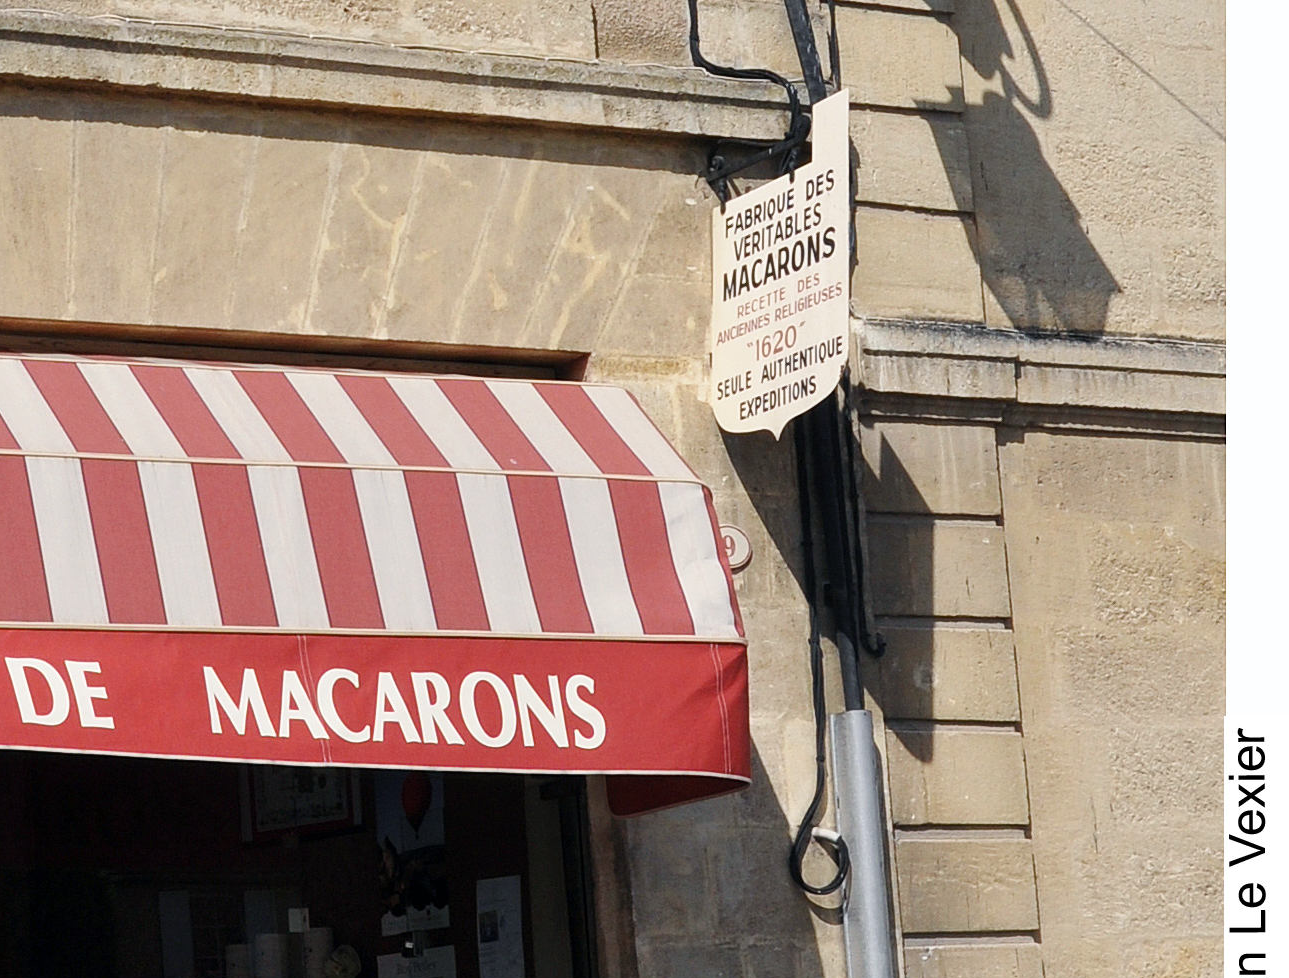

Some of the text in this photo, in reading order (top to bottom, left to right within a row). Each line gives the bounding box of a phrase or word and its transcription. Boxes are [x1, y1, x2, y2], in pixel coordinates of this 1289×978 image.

[725, 169, 835, 239] FABRIQUE DES
[734, 202, 822, 261] VERITABLES
[723, 226, 836, 302] MACARONS
[737, 272, 821, 319] RECETTE DES
[716, 281, 843, 346] ANCIENNES RELIGIEUSES
[717, 335, 843, 401] SEULE AUTHENTIQUE
[739, 375, 817, 421] EXPEDITIONS
[4, 656, 115, 730] DE
[203, 666, 608, 750] MACARONS
